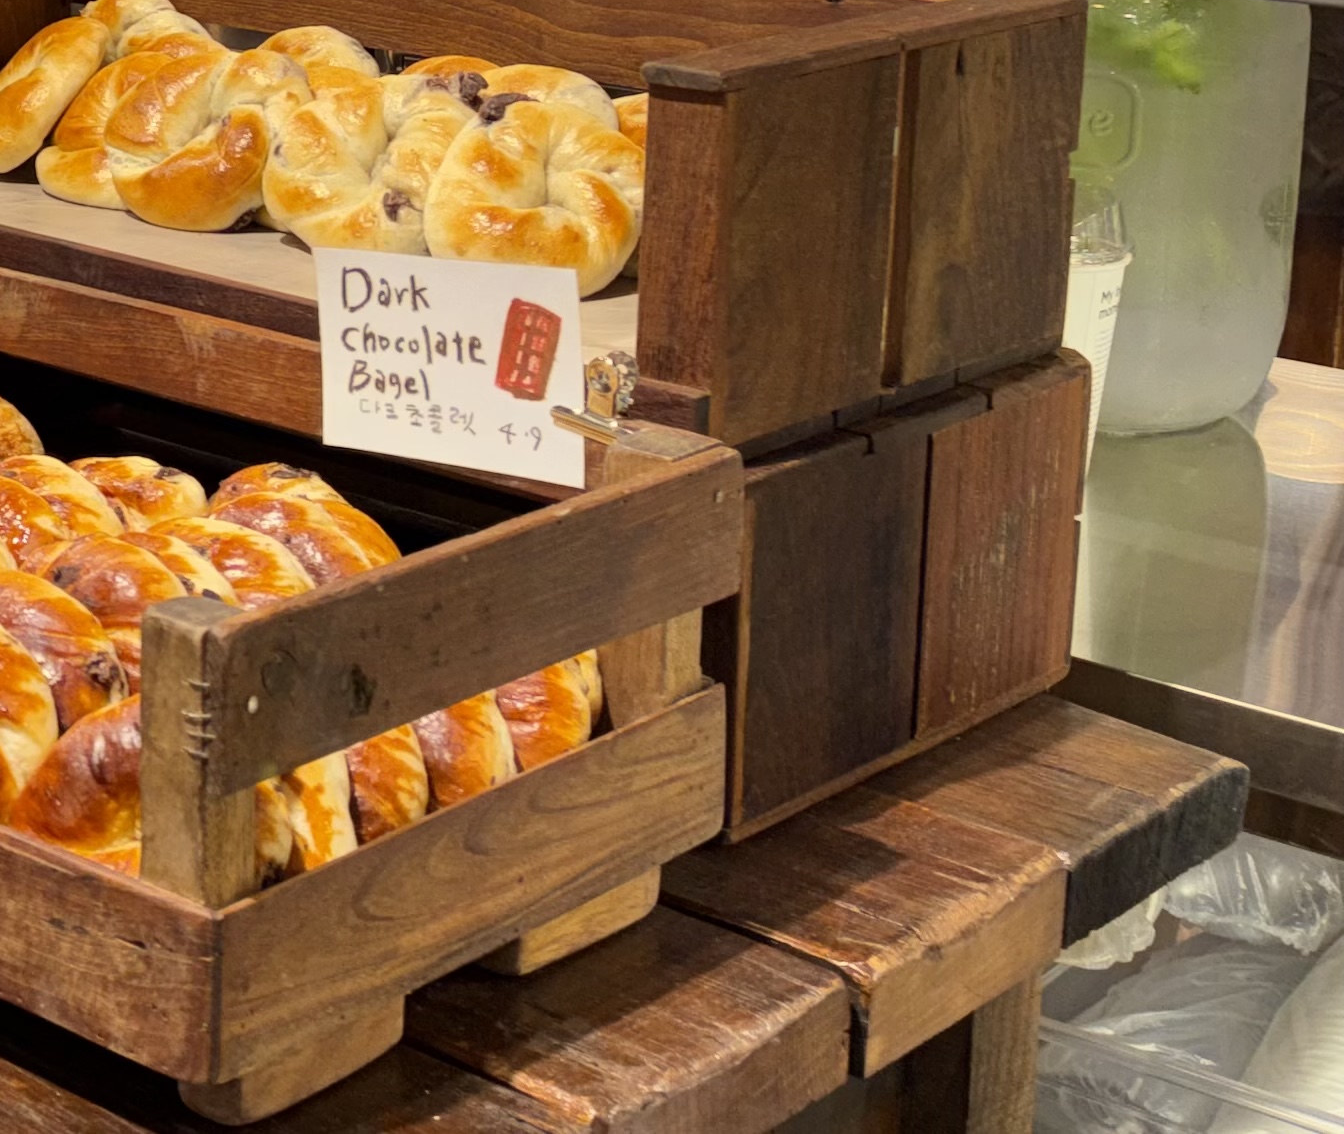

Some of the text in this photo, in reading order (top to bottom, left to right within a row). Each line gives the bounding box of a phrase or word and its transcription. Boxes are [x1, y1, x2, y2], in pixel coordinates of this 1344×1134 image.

[341, 266, 431, 313] Dark
[341, 322, 488, 365] Chocolate
[348, 360, 431, 401] Bagel
[498, 422, 543, 452] 4.9
